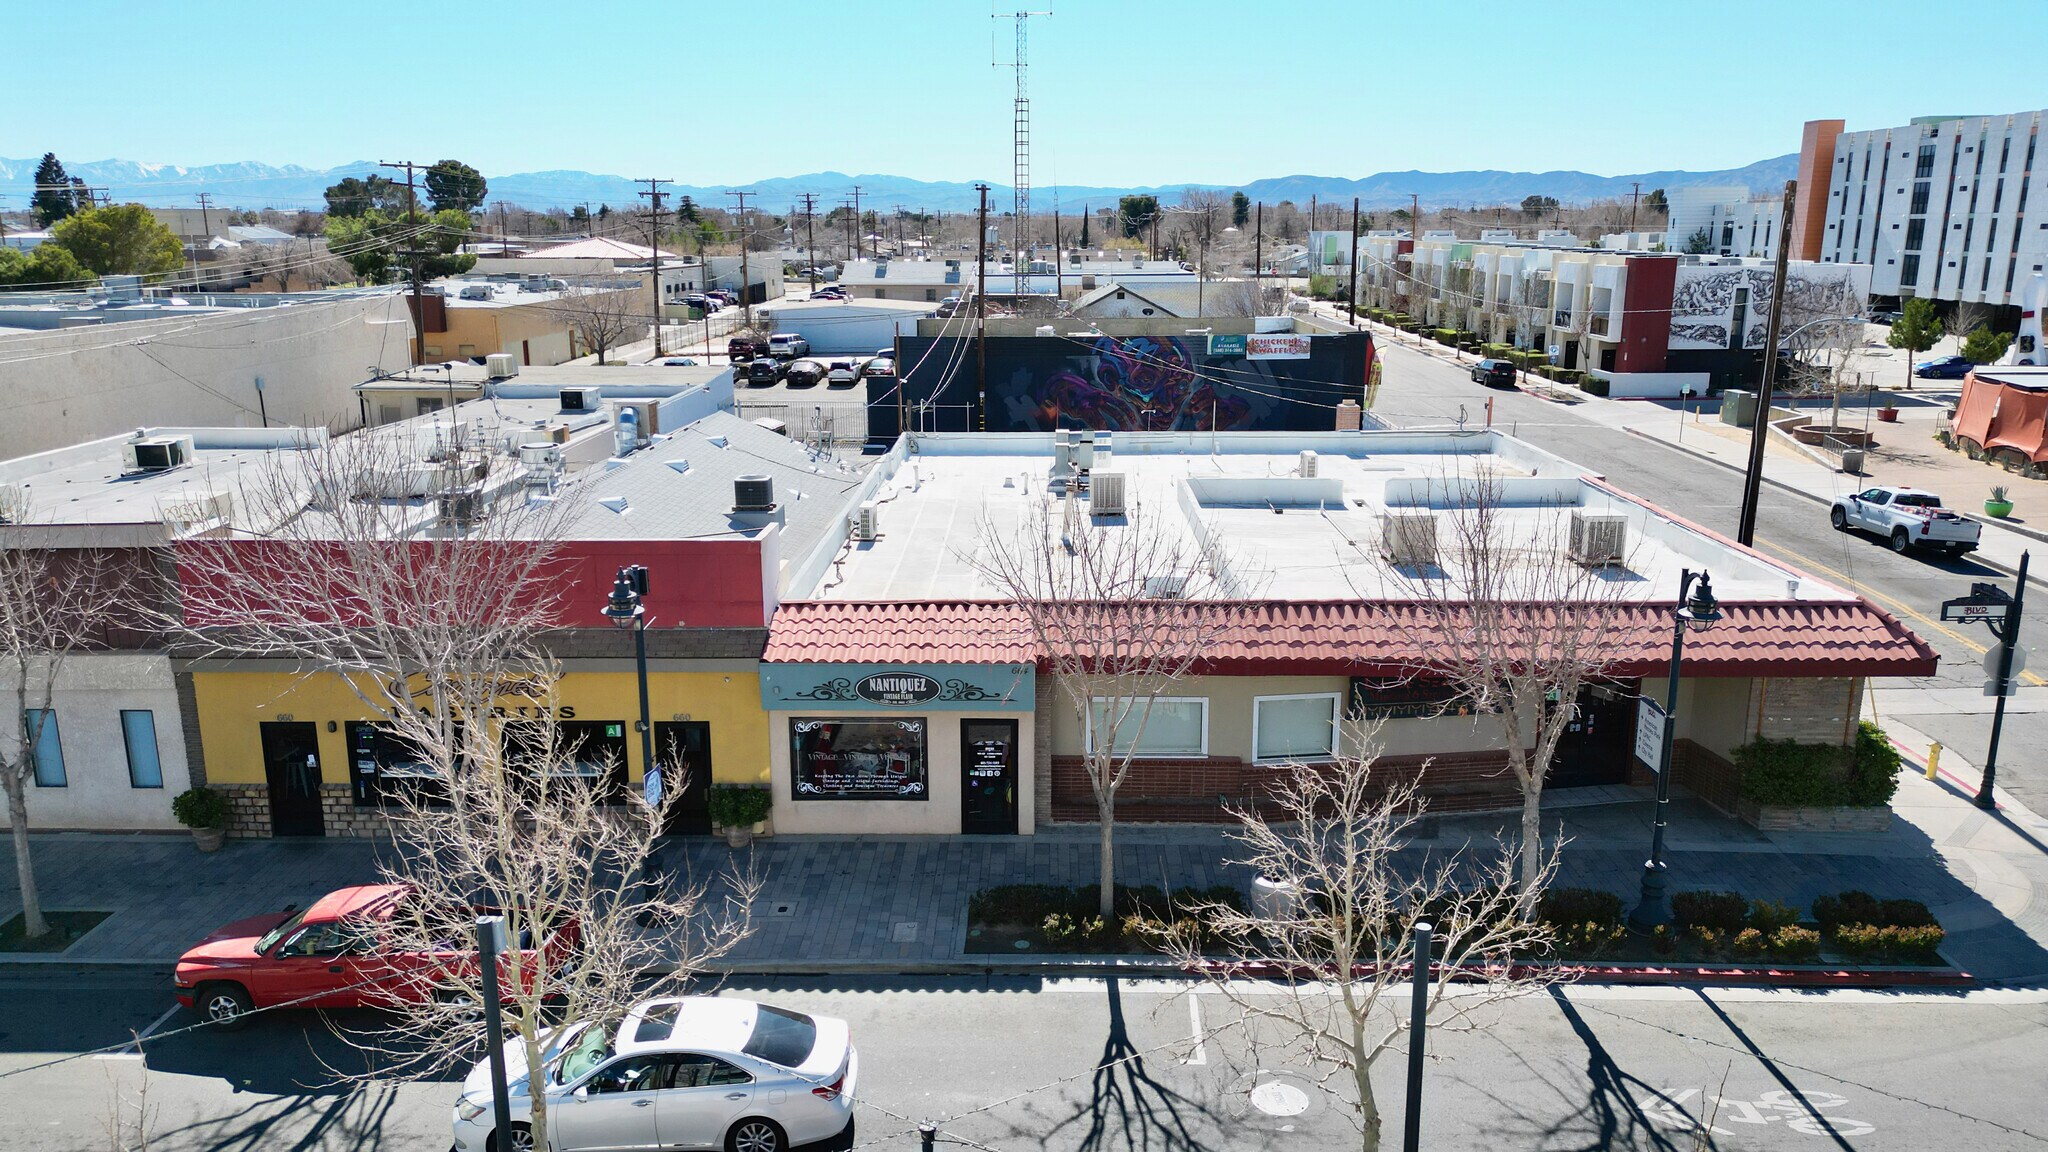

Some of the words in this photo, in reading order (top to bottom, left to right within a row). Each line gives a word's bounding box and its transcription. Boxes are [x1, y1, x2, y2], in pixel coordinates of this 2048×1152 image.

[1964, 606, 1989, 616] BLVD
[868, 677, 927, 694] NANTIQUEZ
[673, 713, 691, 722] 660
[608, 727, 616, 735] A
